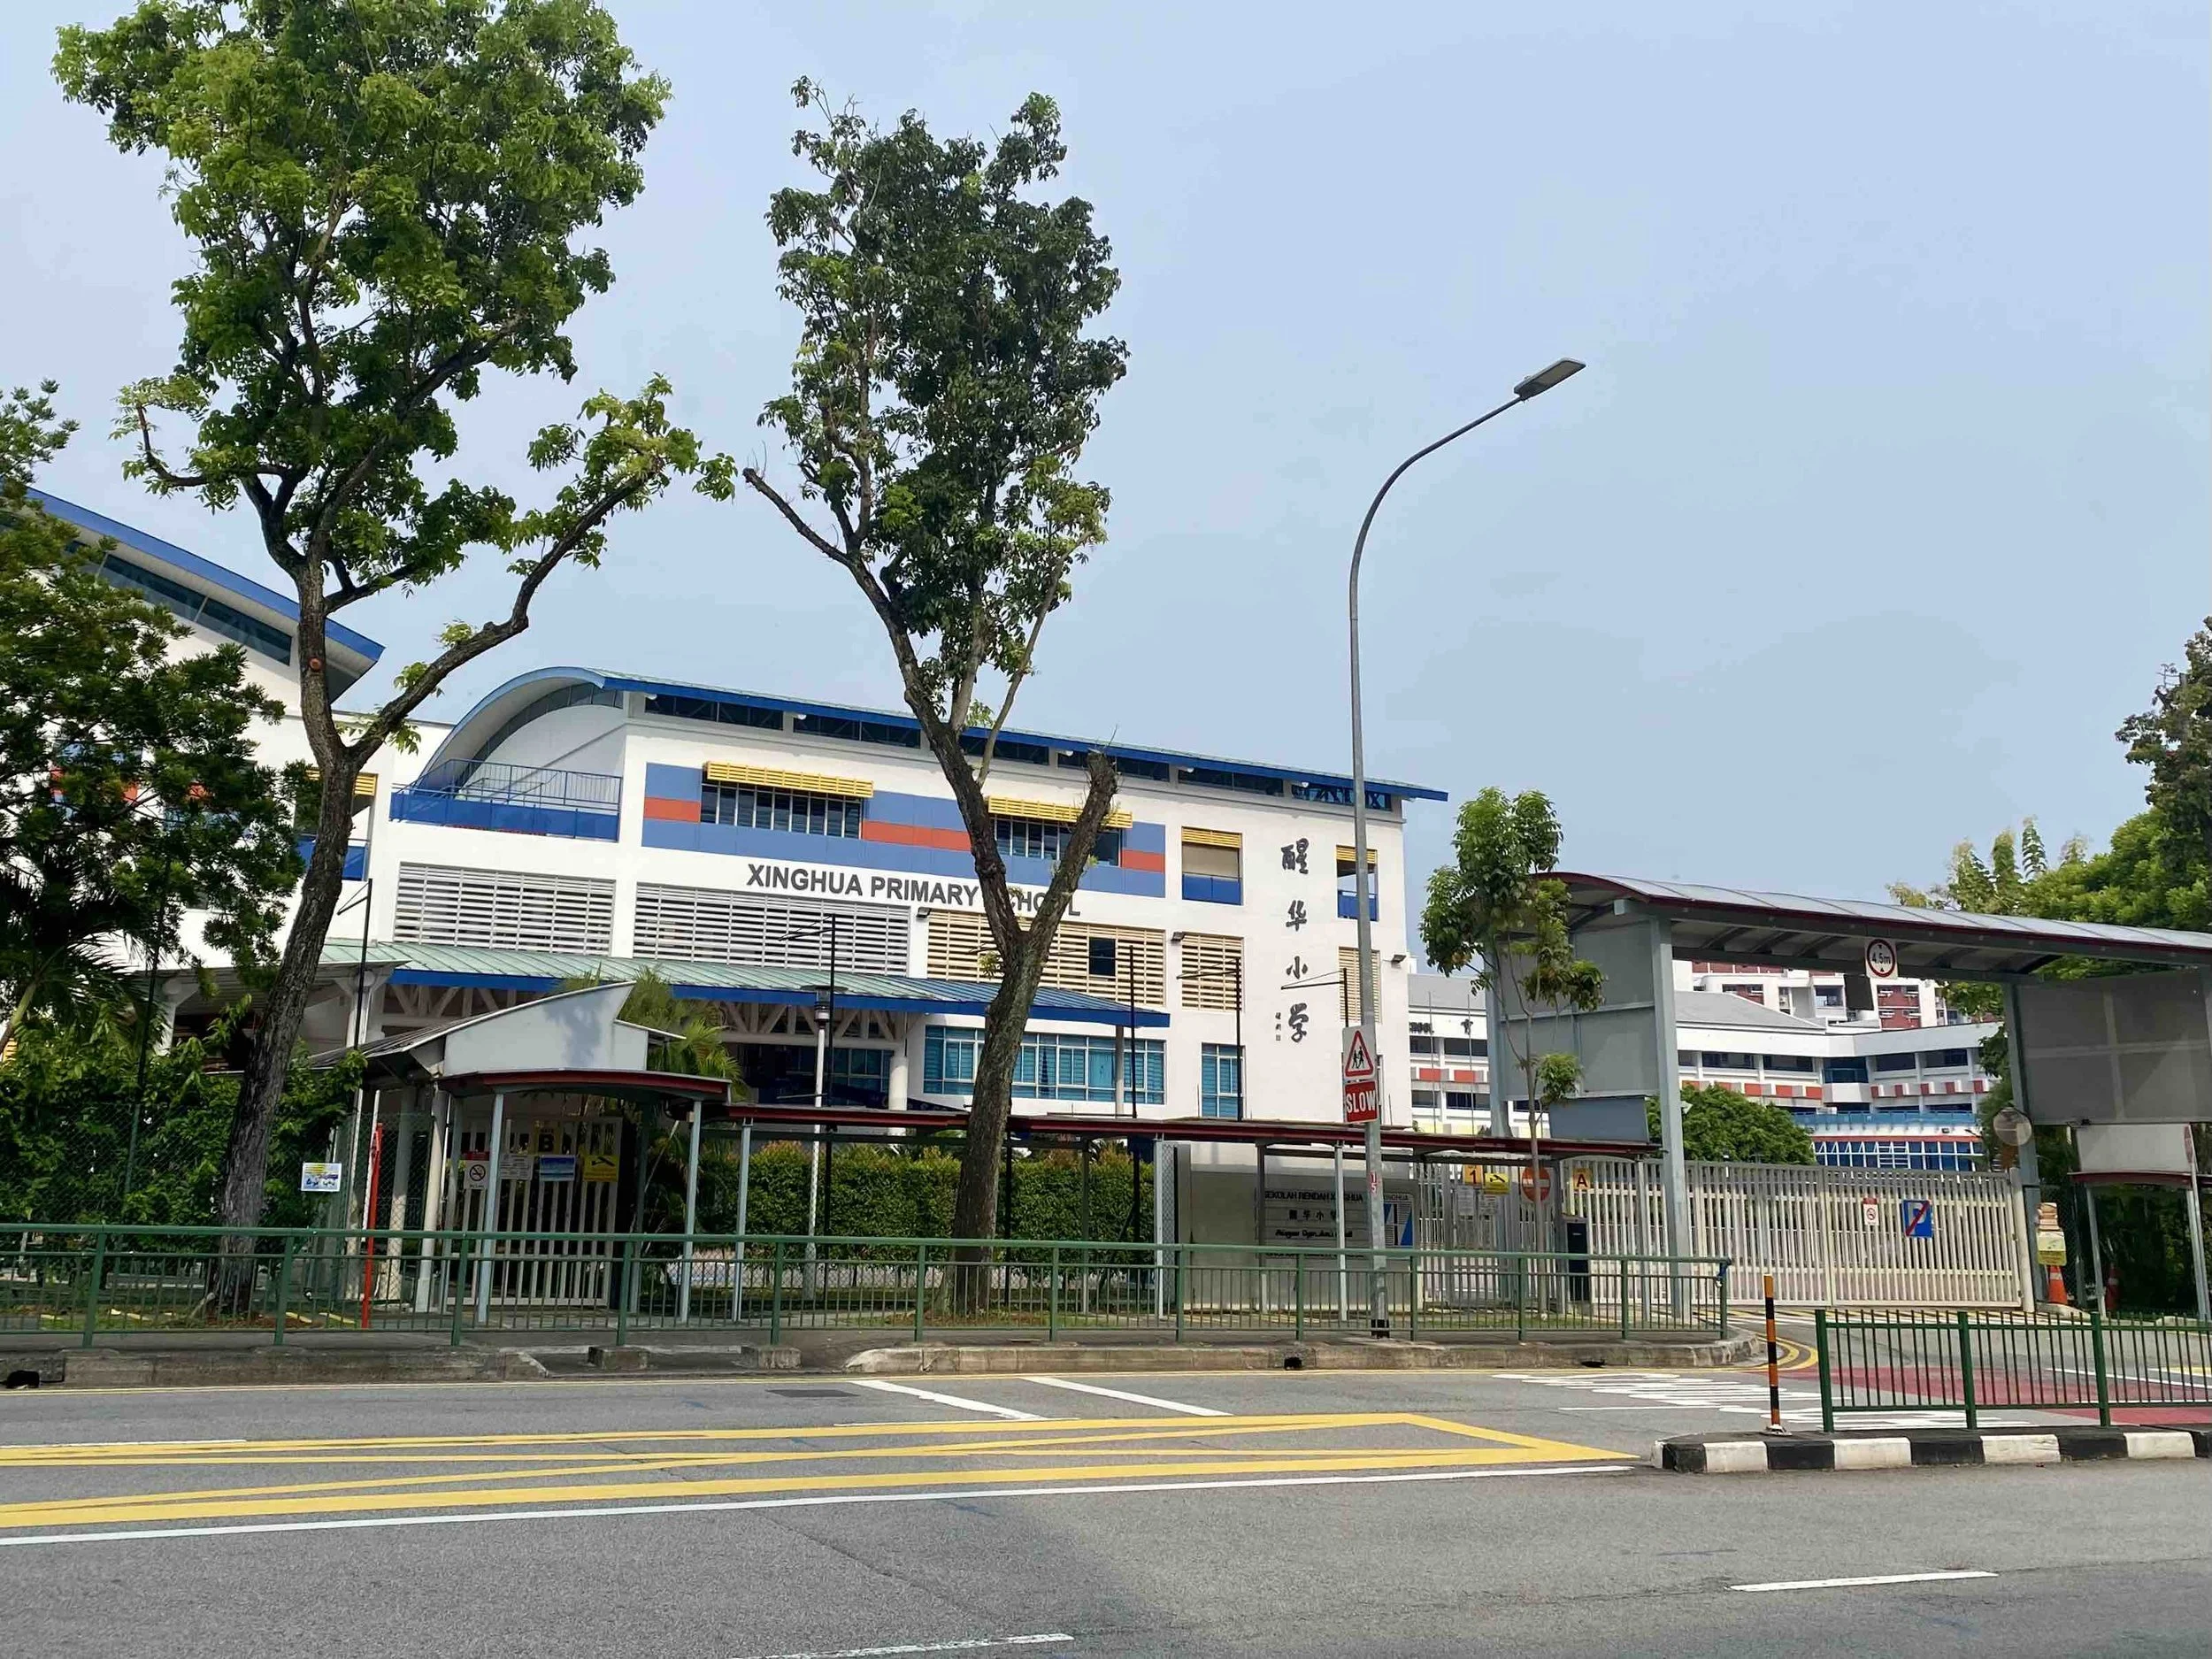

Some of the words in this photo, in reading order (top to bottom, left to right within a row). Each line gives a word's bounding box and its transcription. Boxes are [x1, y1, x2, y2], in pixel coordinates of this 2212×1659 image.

[747, 864, 862, 895] XINGHUA
[872, 876, 979, 906] PRIMARY
[1281, 838, 1309, 1043] 醒华小学
[1872, 953, 1891, 964] 4.5m
[1346, 1089, 1376, 1114] SLOW
[538, 1133, 554, 1152] B
[1470, 1170, 1477, 1185] 1
[1576, 1173, 1588, 1187] A
